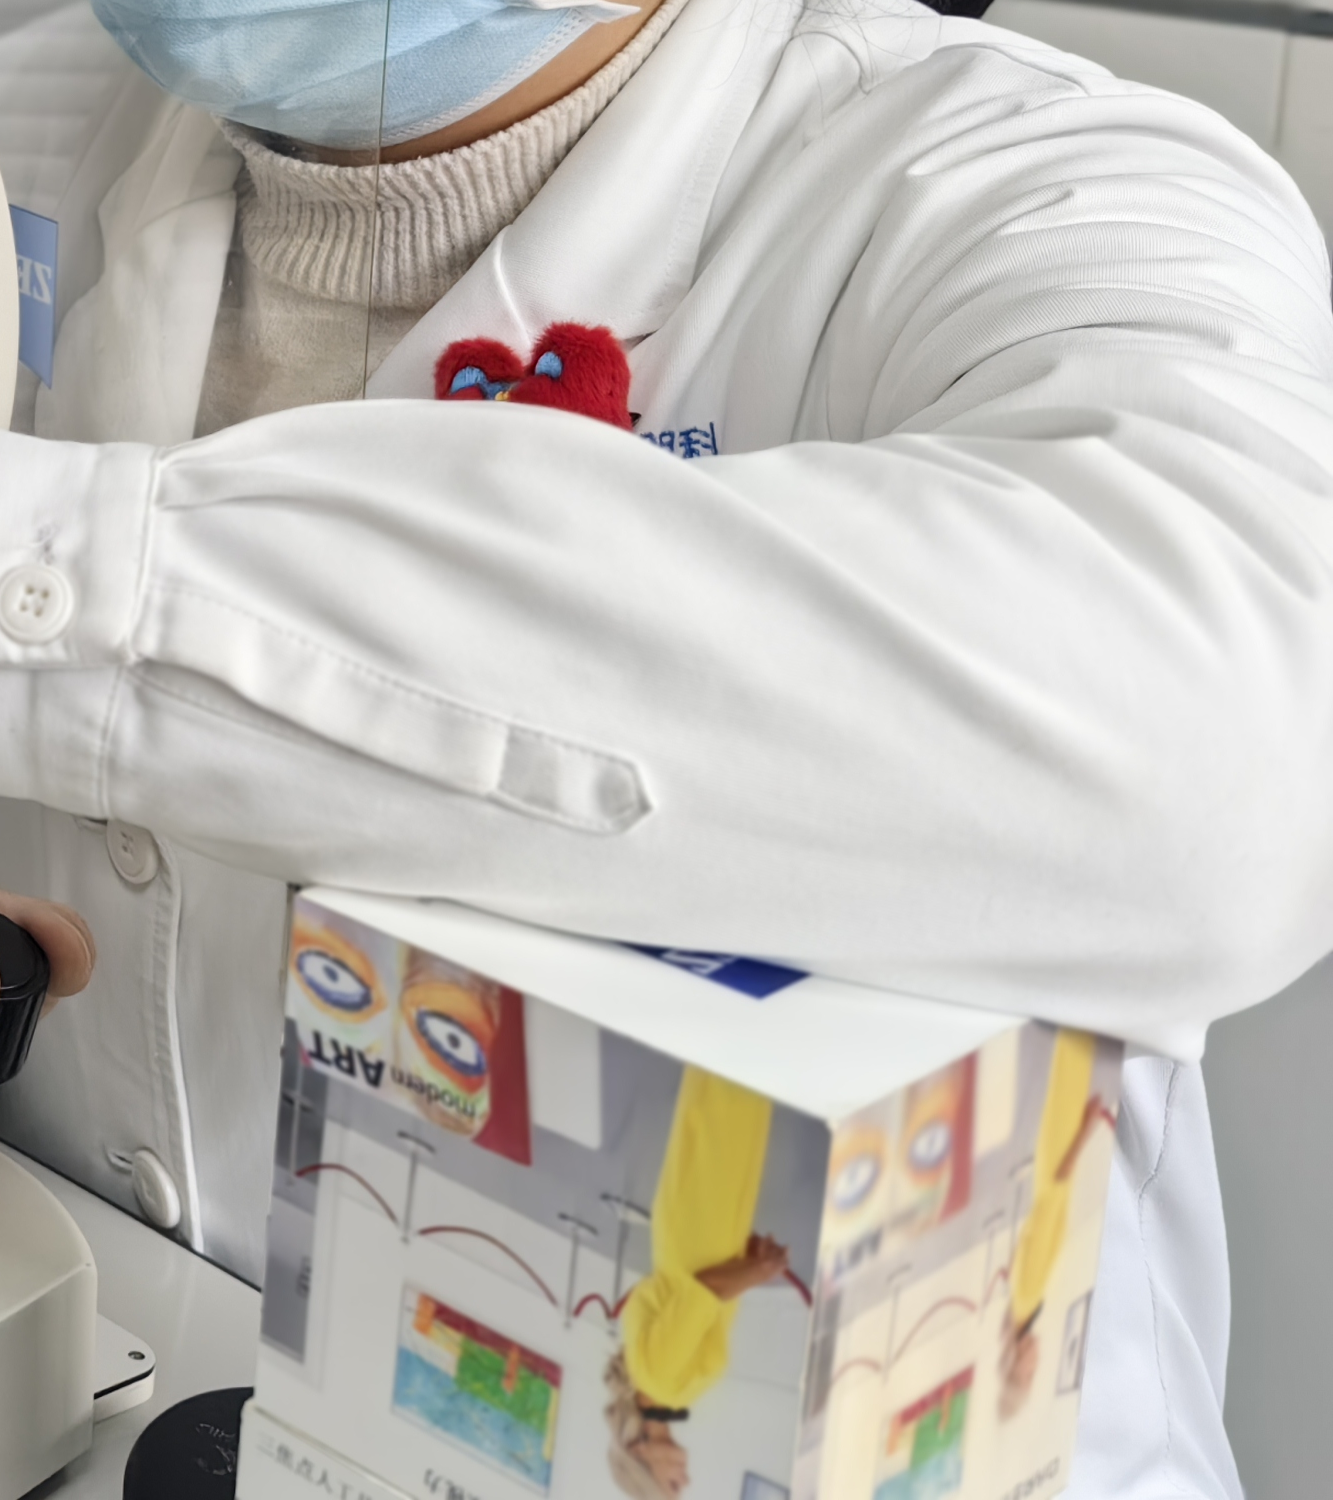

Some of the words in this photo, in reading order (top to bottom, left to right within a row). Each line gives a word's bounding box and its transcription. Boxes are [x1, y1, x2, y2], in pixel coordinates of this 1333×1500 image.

[308, 1029, 385, 1088] ART
[390, 1066, 476, 1116] modern
[256, 1431, 373, 1500] 三焦点人工
